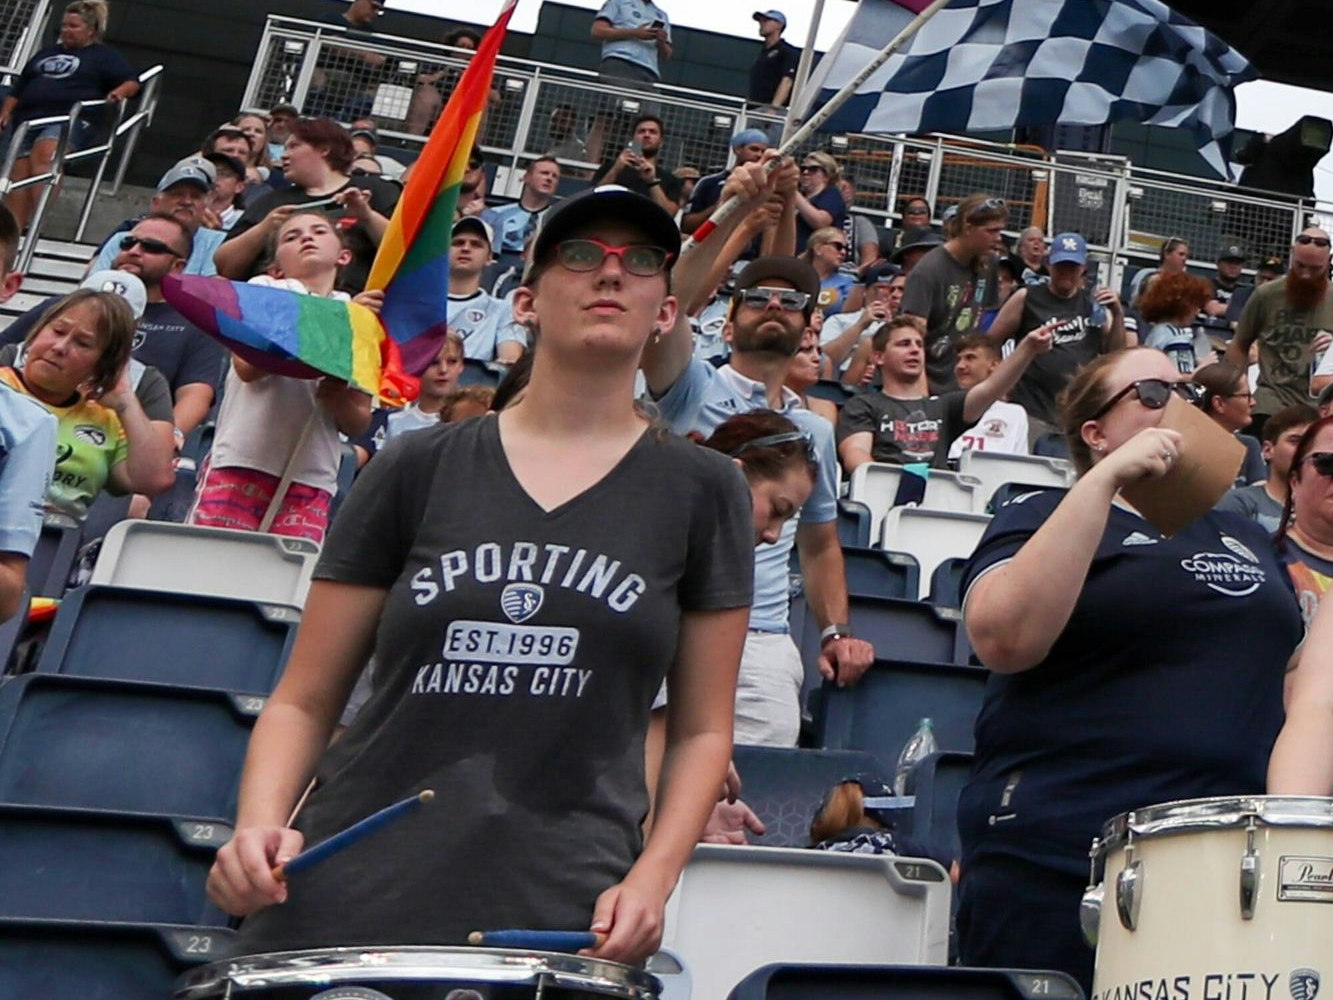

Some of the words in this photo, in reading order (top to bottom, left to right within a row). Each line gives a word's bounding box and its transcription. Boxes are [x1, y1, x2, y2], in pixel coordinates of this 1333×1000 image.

[410, 541, 647, 613] SPORTING
[271, 608, 286, 619] 23
[412, 663, 519, 695] KANSAS
[530, 666, 593, 698] CITY
[246, 698, 263, 711] 23
[192, 825, 213, 840] 23
[905, 866, 921, 878] 21
[187, 935, 211, 954] 23
[1032, 979, 1049, 994] 21
[1203, 973, 1281, 1000] CITY
